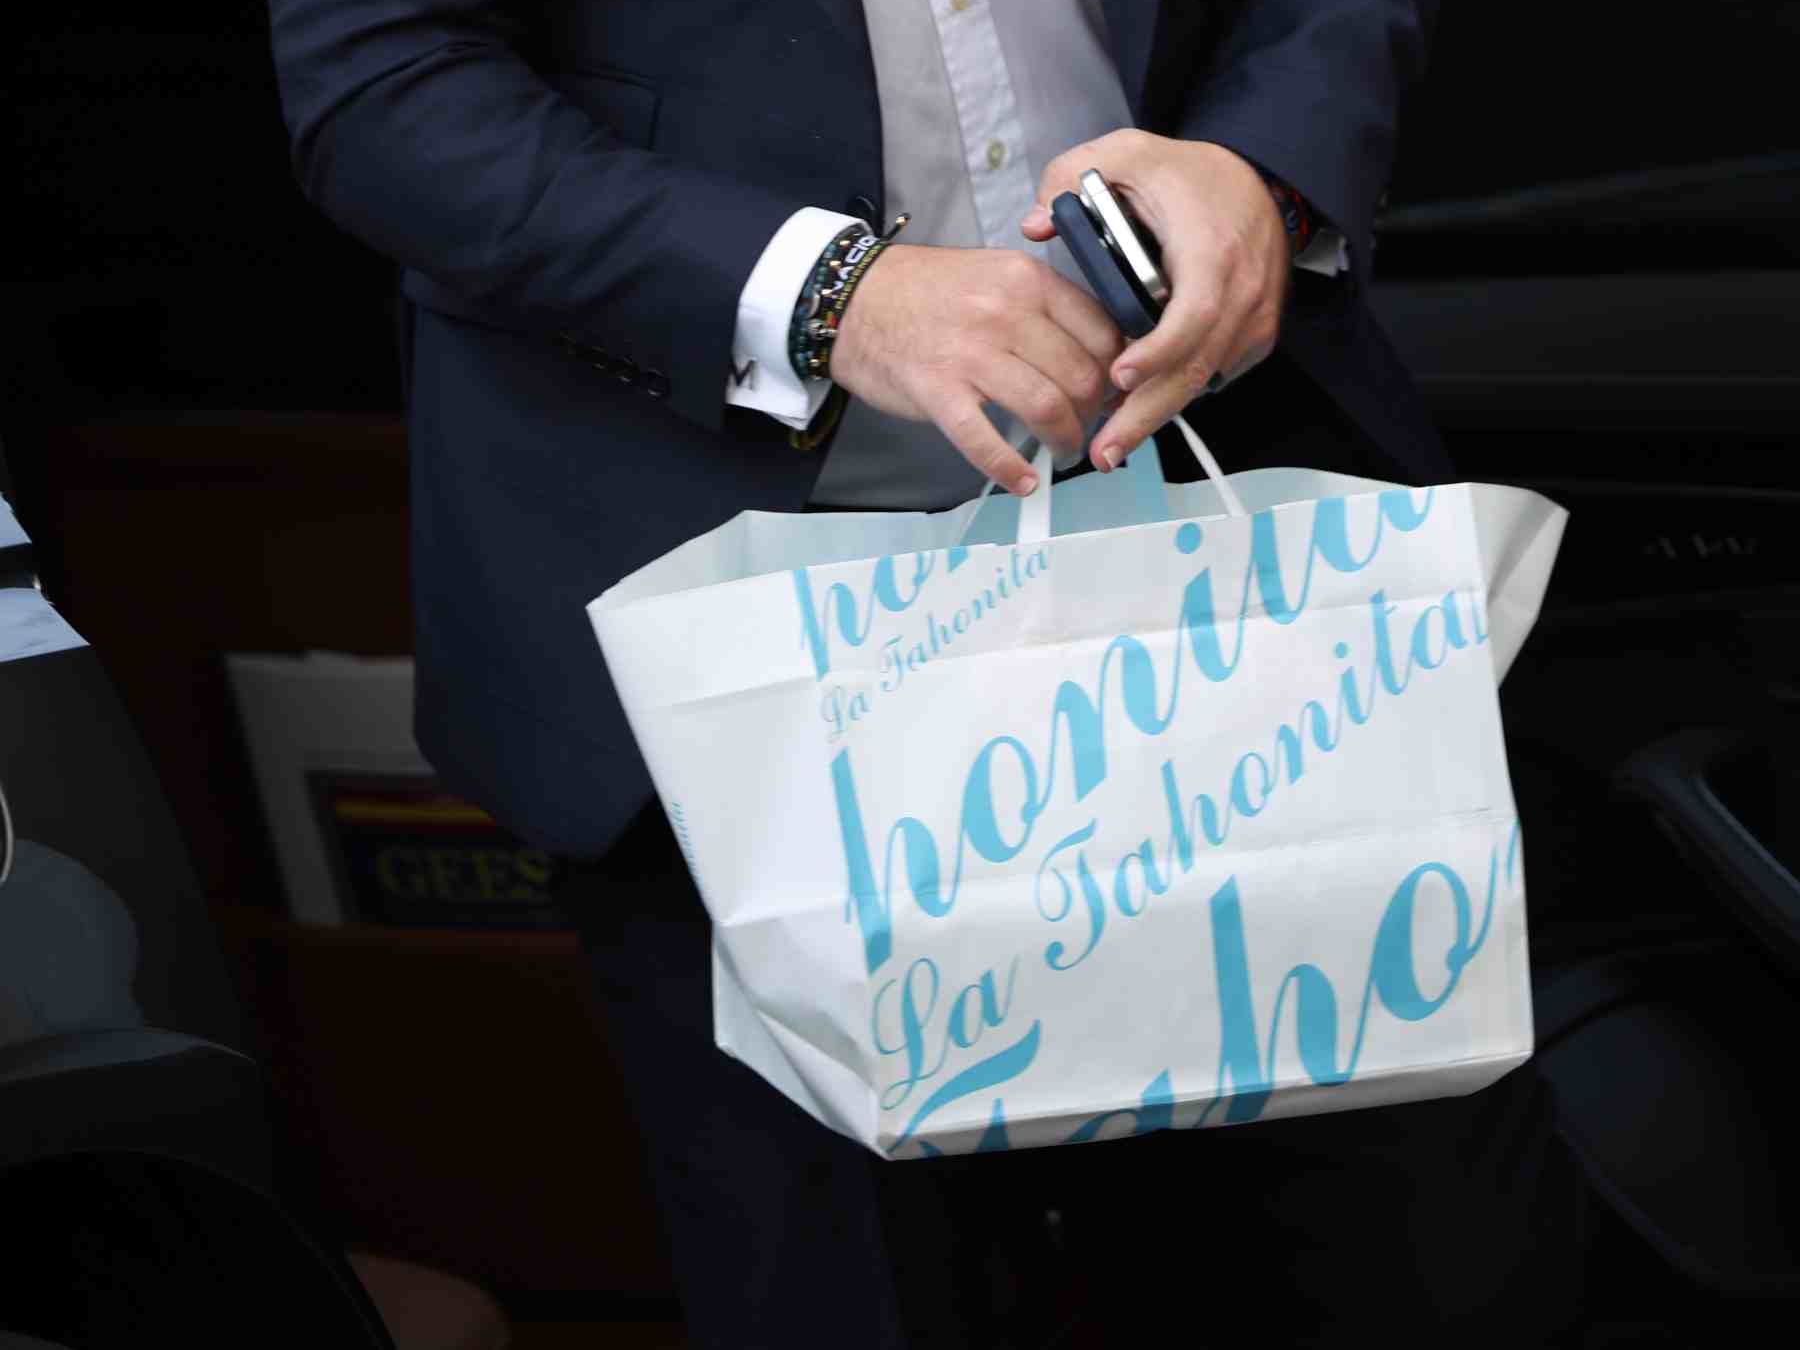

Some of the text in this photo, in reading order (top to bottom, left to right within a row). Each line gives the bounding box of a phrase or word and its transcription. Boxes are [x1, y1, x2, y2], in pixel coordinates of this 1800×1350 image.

[793, 545, 969, 683] ho
[820, 547, 1050, 743] La Tahonita
[872, 588, 1470, 1111] La Tahonita
